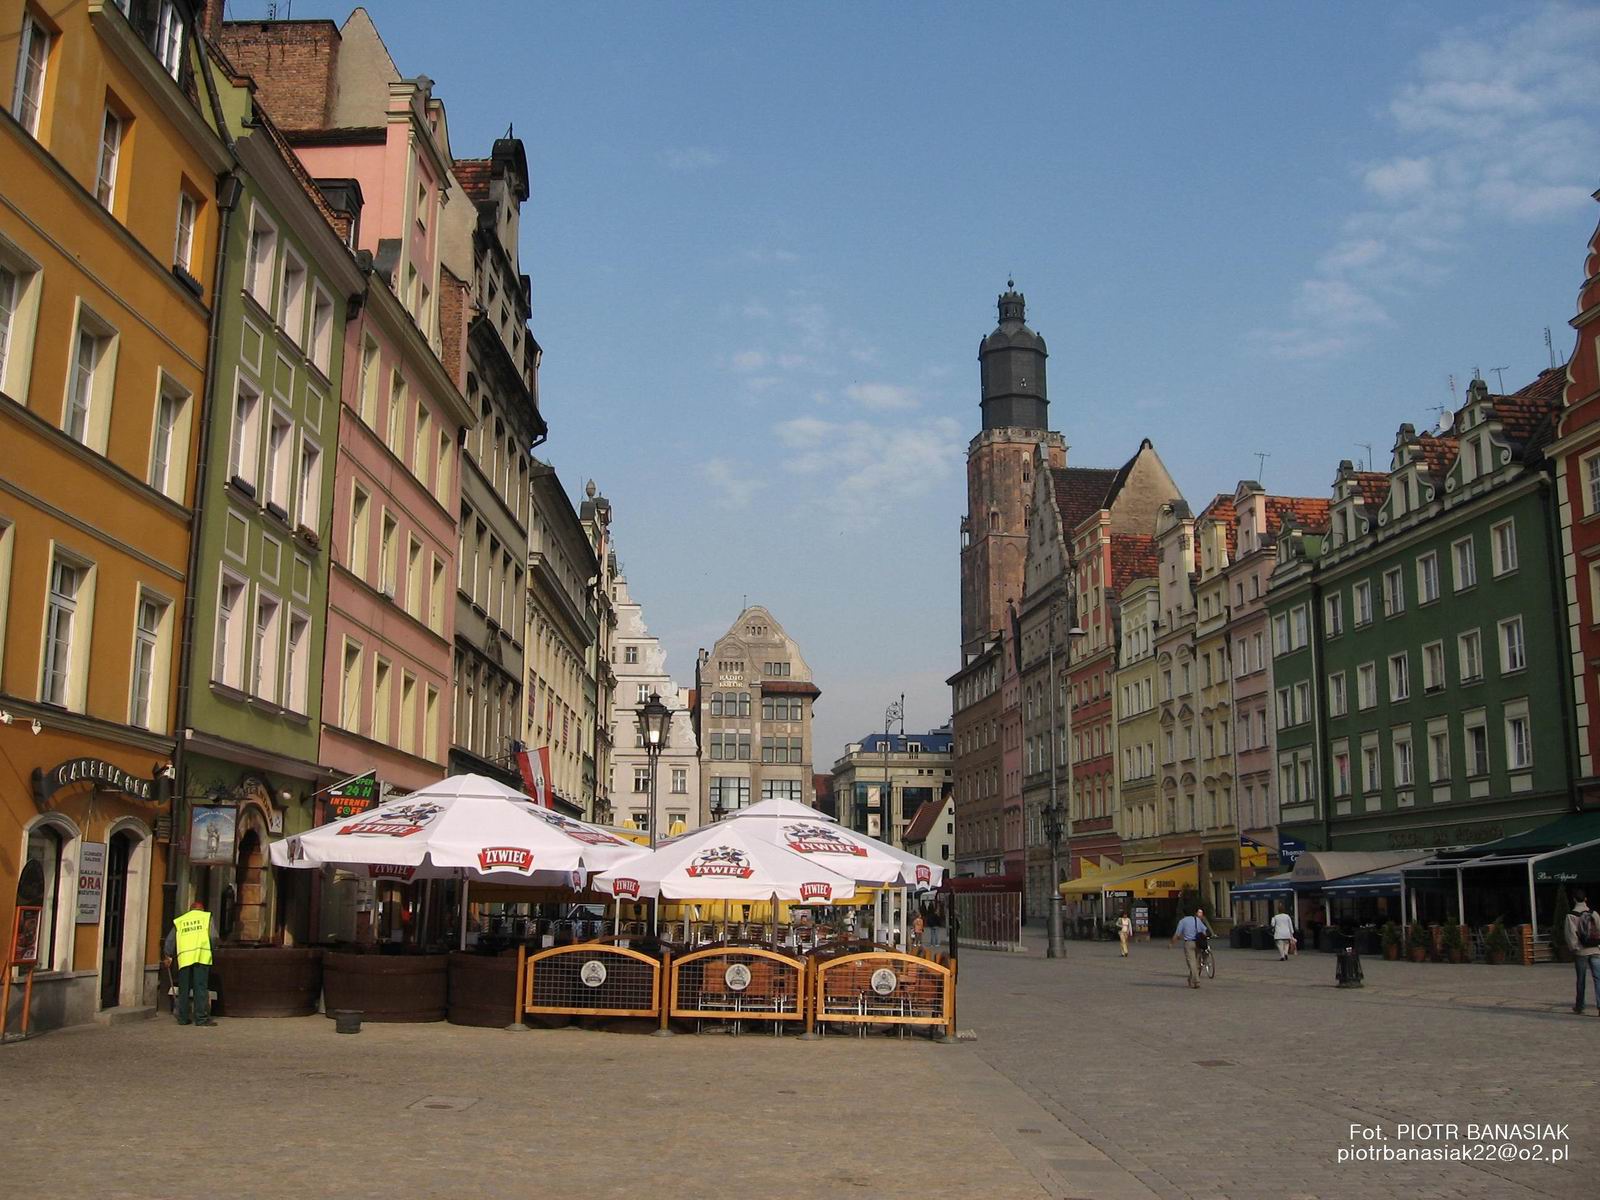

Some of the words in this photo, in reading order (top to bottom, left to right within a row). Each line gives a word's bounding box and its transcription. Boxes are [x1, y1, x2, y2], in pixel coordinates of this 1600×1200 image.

[355, 778, 374, 786] OPEN
[345, 785, 359, 796] 24
[362, 786, 372, 797] H
[330, 797, 370, 807] INTERNET
[485, 848, 527, 864] ŻYWIEC
[79, 876, 101, 889] ORA
[804, 883, 829, 896] ŻYWIEC
